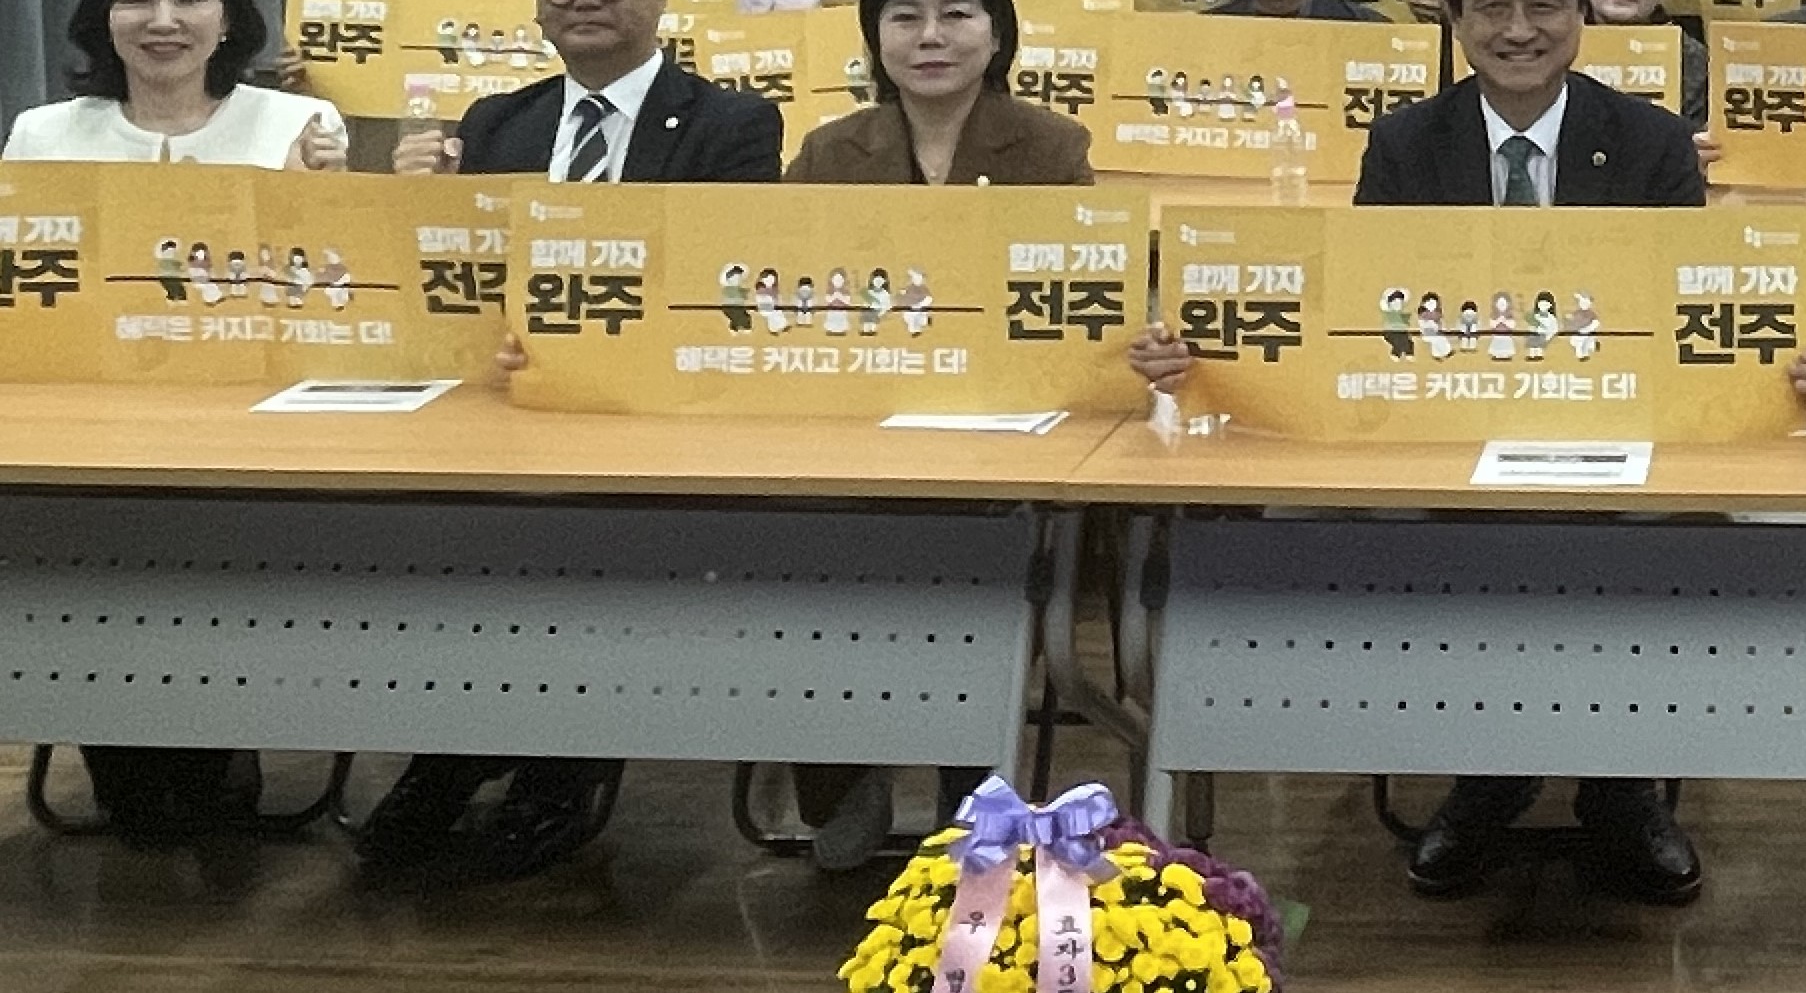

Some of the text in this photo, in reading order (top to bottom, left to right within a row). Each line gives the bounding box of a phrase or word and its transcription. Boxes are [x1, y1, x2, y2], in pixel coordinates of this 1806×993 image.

[299, 21, 384, 63] 완주
[1724, 88, 1806, 133] 완주
[25, 217, 81, 244] 가자
[475, 229, 510, 254] 가
[591, 241, 647, 269] 가자
[1070, 245, 1127, 272] 가자
[1246, 265, 1304, 295] 가자
[1740, 267, 1798, 295] 가자
[525, 274, 643, 334] 완주
[1007, 280, 1125, 341] 전주
[201, 318, 273, 342] 커지고
[281, 320, 353, 345] 기회는
[360, 322, 394, 345] 더!
[1180, 299, 1302, 362] 완주
[1676, 304, 1797, 365] 전주
[762, 348, 840, 373] 커지고
[848, 349, 925, 375] 기회는
[933, 350, 967, 374] 더!
[1337, 372, 1637, 401] 혜택은 커지고 기회는 더!
